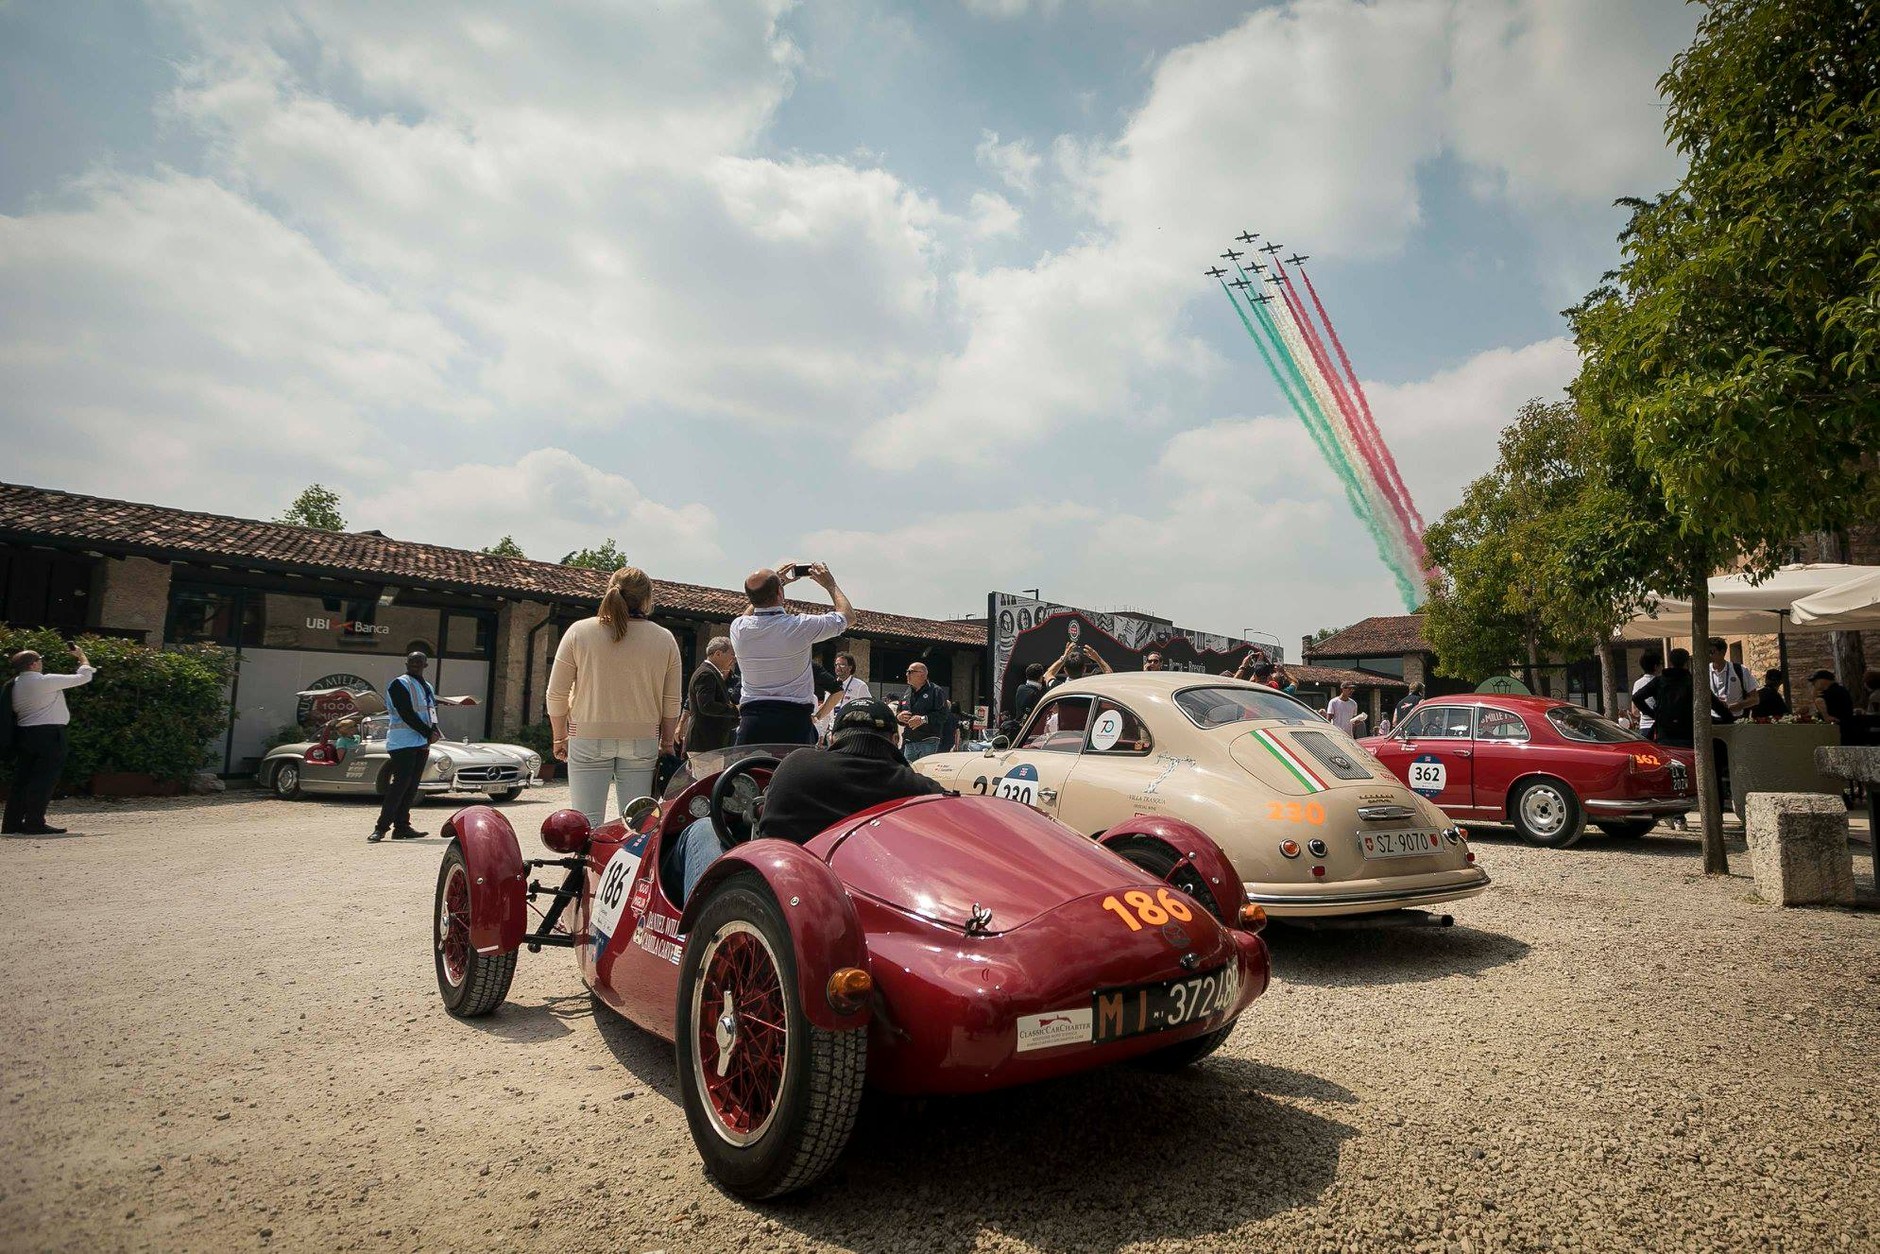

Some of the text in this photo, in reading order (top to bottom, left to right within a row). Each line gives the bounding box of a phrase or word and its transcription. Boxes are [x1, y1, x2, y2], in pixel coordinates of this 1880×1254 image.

[306, 618, 390, 634] UBI Banca
[323, 702, 354, 711] 1000
[1634, 754, 1661, 766] 362
[1415, 766, 1440, 782] 362
[1003, 784, 1032, 805] 230
[1265, 801, 1326, 826] 230
[600, 860, 632, 910] 186
[1102, 887, 1193, 932] 186
